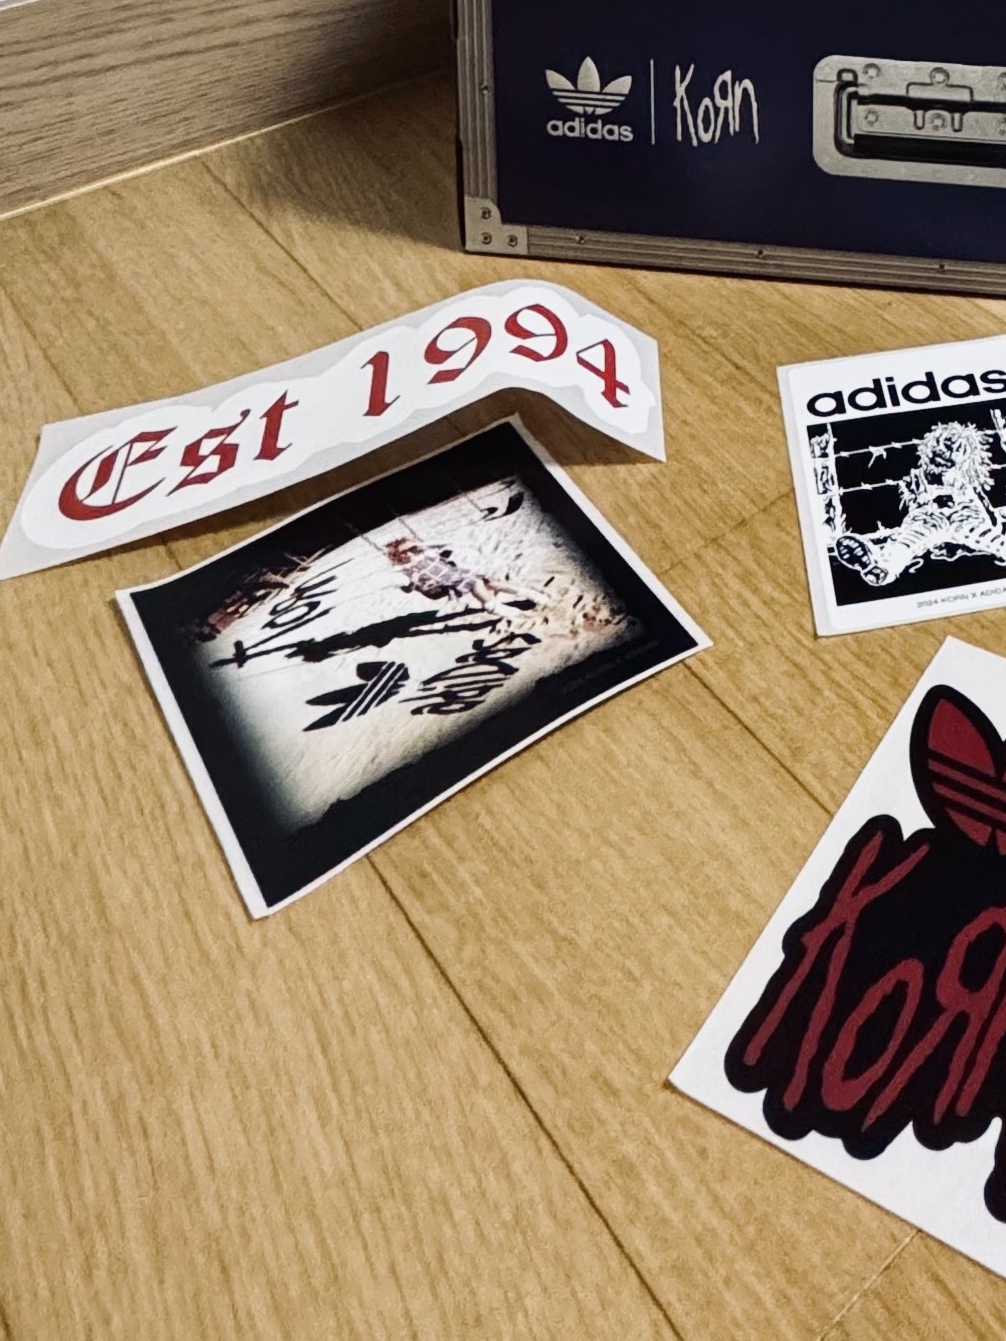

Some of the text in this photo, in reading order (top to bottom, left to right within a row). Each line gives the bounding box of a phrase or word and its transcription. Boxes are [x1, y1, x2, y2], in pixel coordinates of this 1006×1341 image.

[546, 117, 634, 142] adidas
[58, 303, 631, 522] Est 1994
